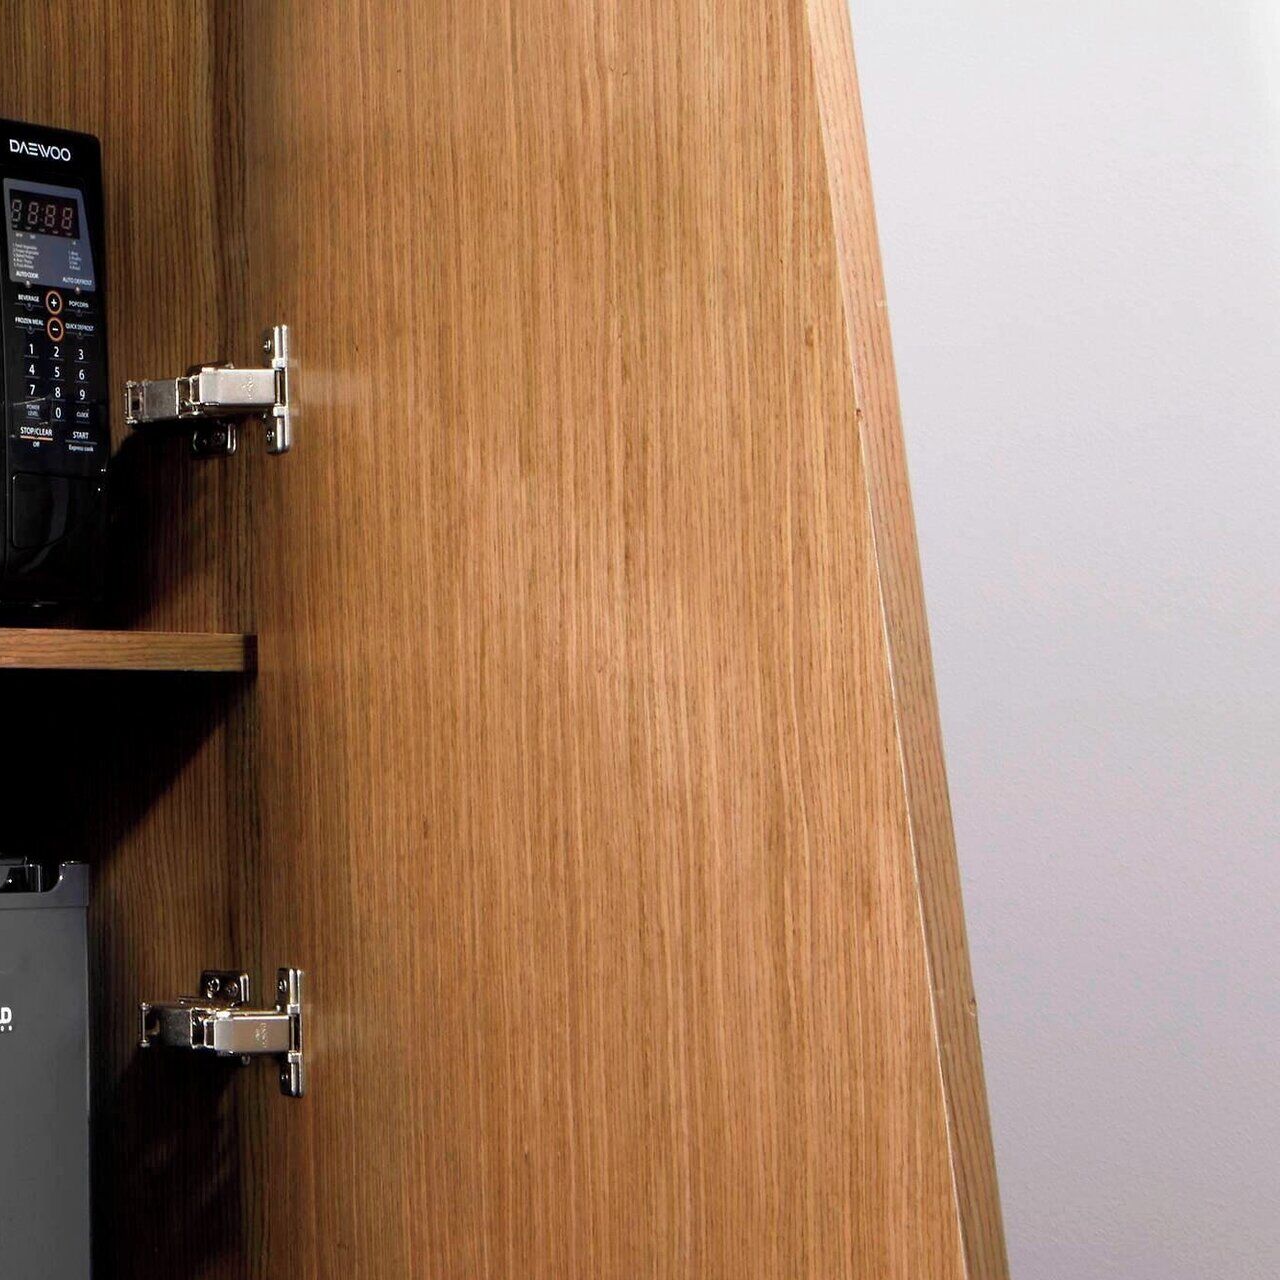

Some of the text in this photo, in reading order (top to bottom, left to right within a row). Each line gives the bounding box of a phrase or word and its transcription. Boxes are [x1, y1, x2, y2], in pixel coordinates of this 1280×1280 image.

[9, 138, 72, 162] DAEWOO
[17, 293, 40, 303] BEVERAGE
[68, 300, 89, 308] POPCORN
[29, 343, 34, 355] 1
[53, 346, 60, 358] 2
[78, 348, 85, 361] 3
[28, 363, 36, 376] 4
[54, 366, 61, 378] 5
[78, 369, 85, 381] 6
[29, 384, 36, 396] 7
[54, 386, 61, 399] 8
[79, 388, 86, 401] 9
[55, 407, 62, 419] 0
[20, 426, 53, 437] STOP/CLEAR
[72, 431, 89, 440] START
